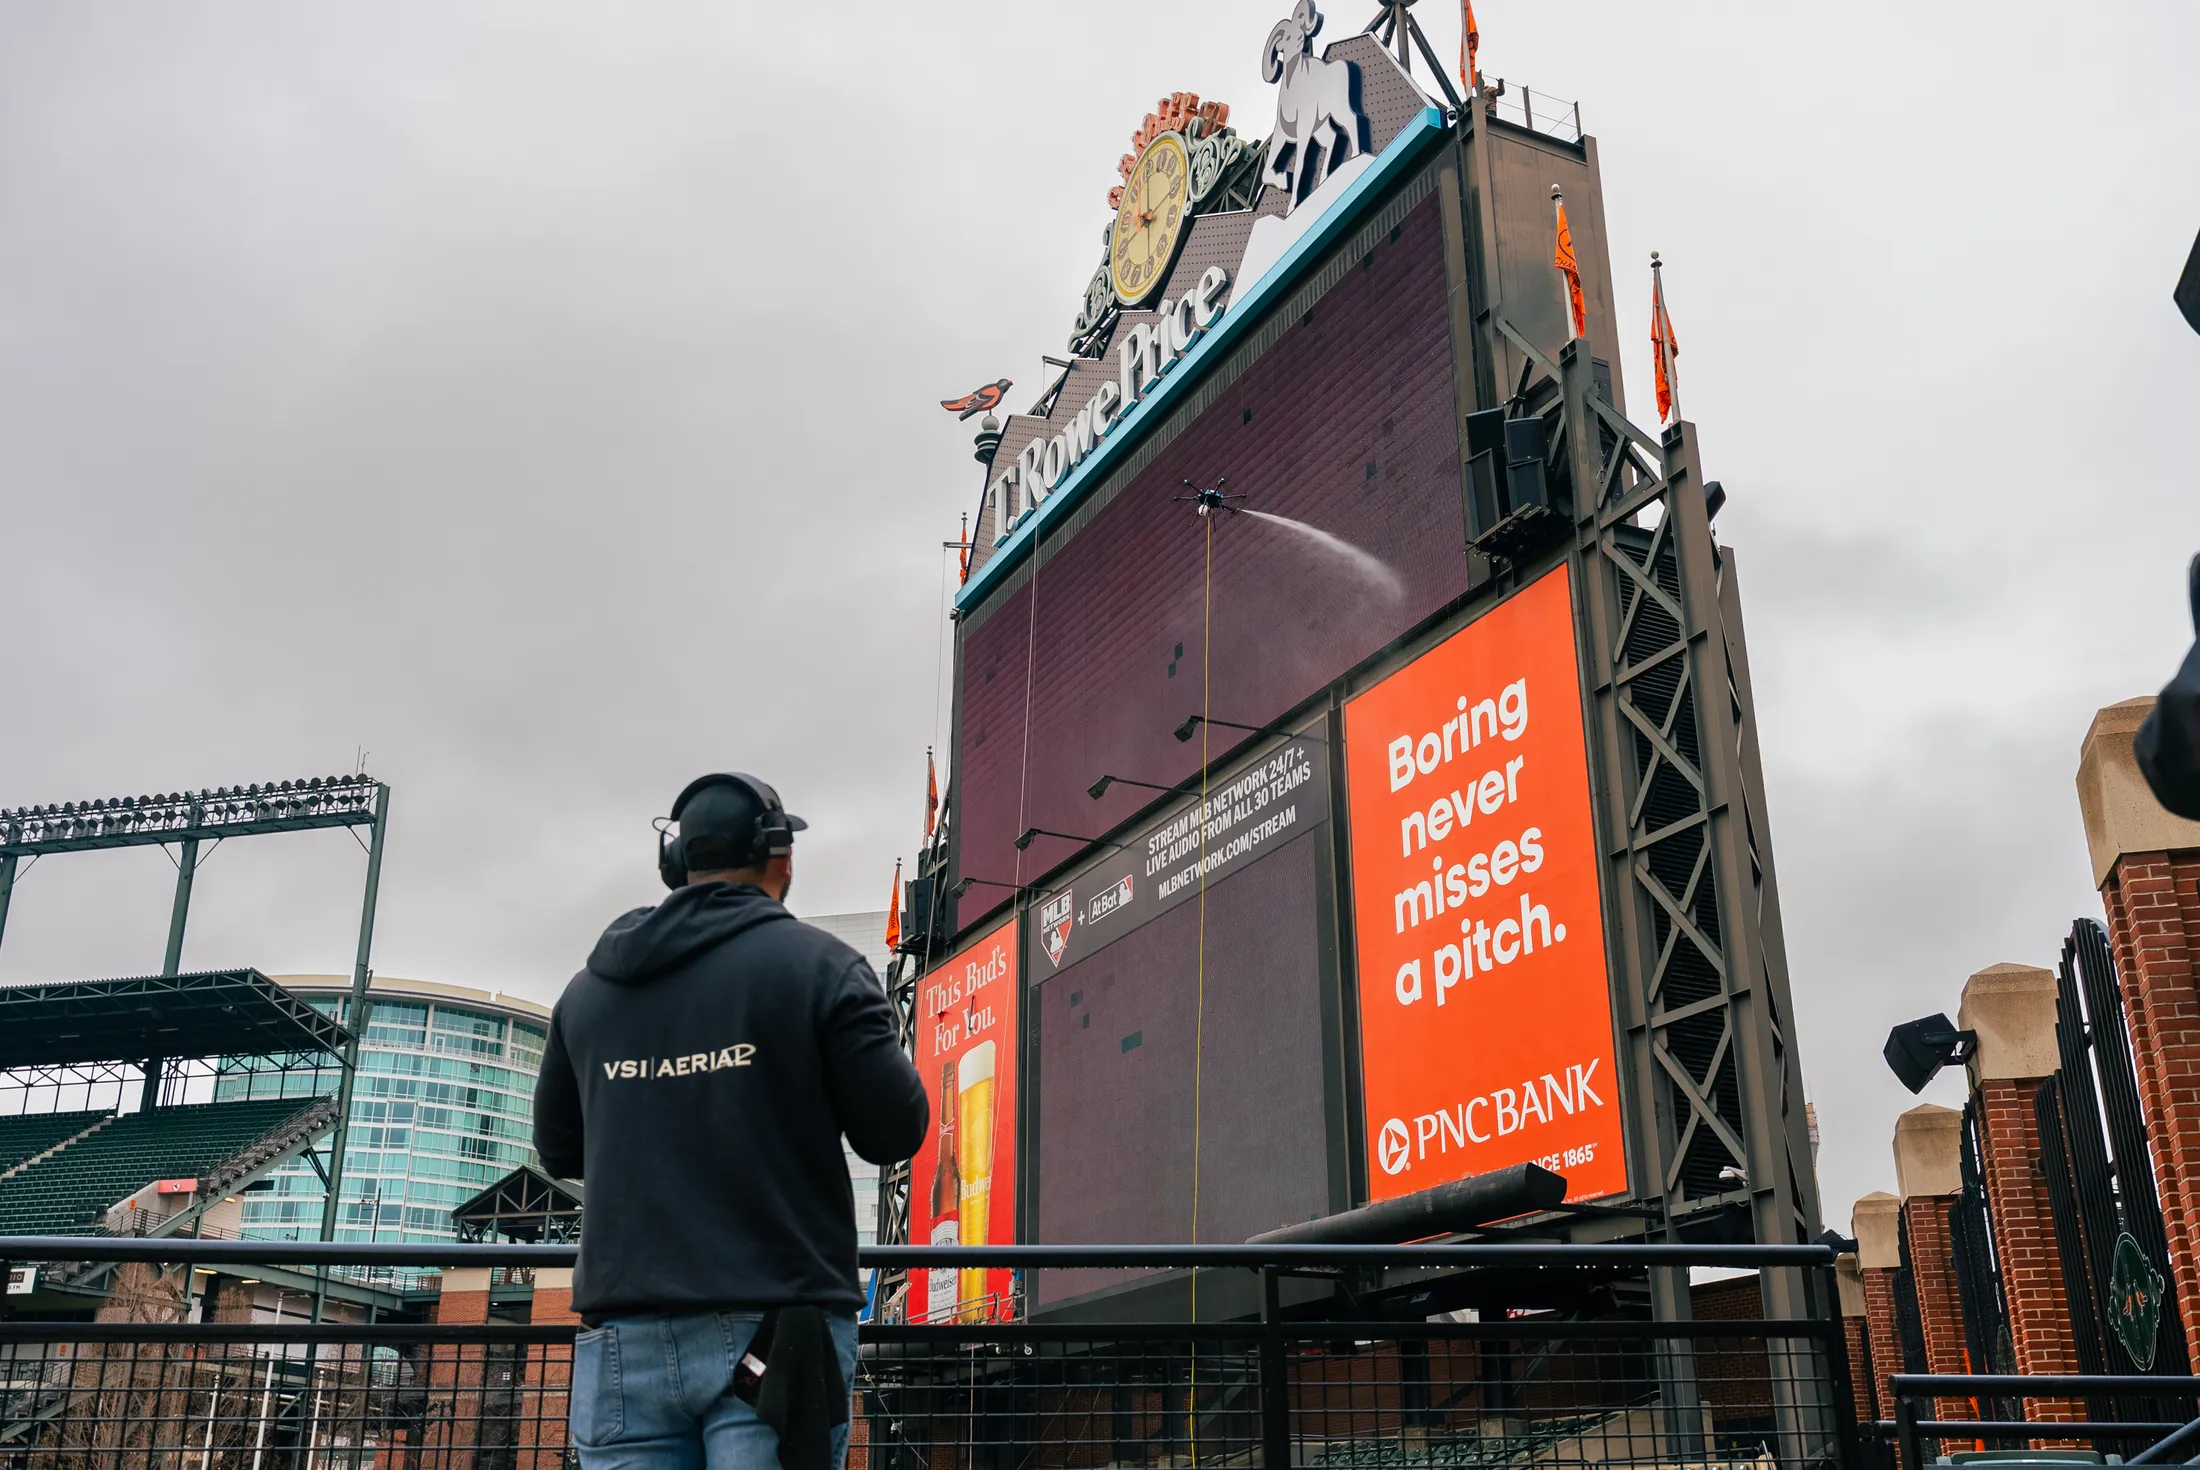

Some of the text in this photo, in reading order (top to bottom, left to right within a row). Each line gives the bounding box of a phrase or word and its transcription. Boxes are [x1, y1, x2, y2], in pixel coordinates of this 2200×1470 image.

[1017, 381, 1120, 517] Rowe
[1117, 266, 1227, 417] Price
[1388, 677, 1528, 793] Boring
[1146, 761, 1312, 878] LIVE AUDIO FROM ALL 30 TEAMS
[1148, 815, 1189, 855] STREAM
[1189, 801, 1212, 831] MLB
[1213, 764, 1269, 816] NETWORK
[1269, 747, 1295, 780] 24/7
[1158, 805, 1296, 900] MLBNETWORK.COM/STREAM
[1401, 754, 1524, 858] never
[1043, 893, 1071, 928] MLB
[1394, 827, 1544, 935] misses
[926, 945, 1007, 1019] This Bud's
[1395, 892, 1567, 1007] a pitch.
[603, 1059, 648, 1080] VSI
[934, 1005, 996, 1058] For You.
[1413, 1058, 1604, 1160] PNC BANK
[1562, 1144, 1595, 1168] 1865
